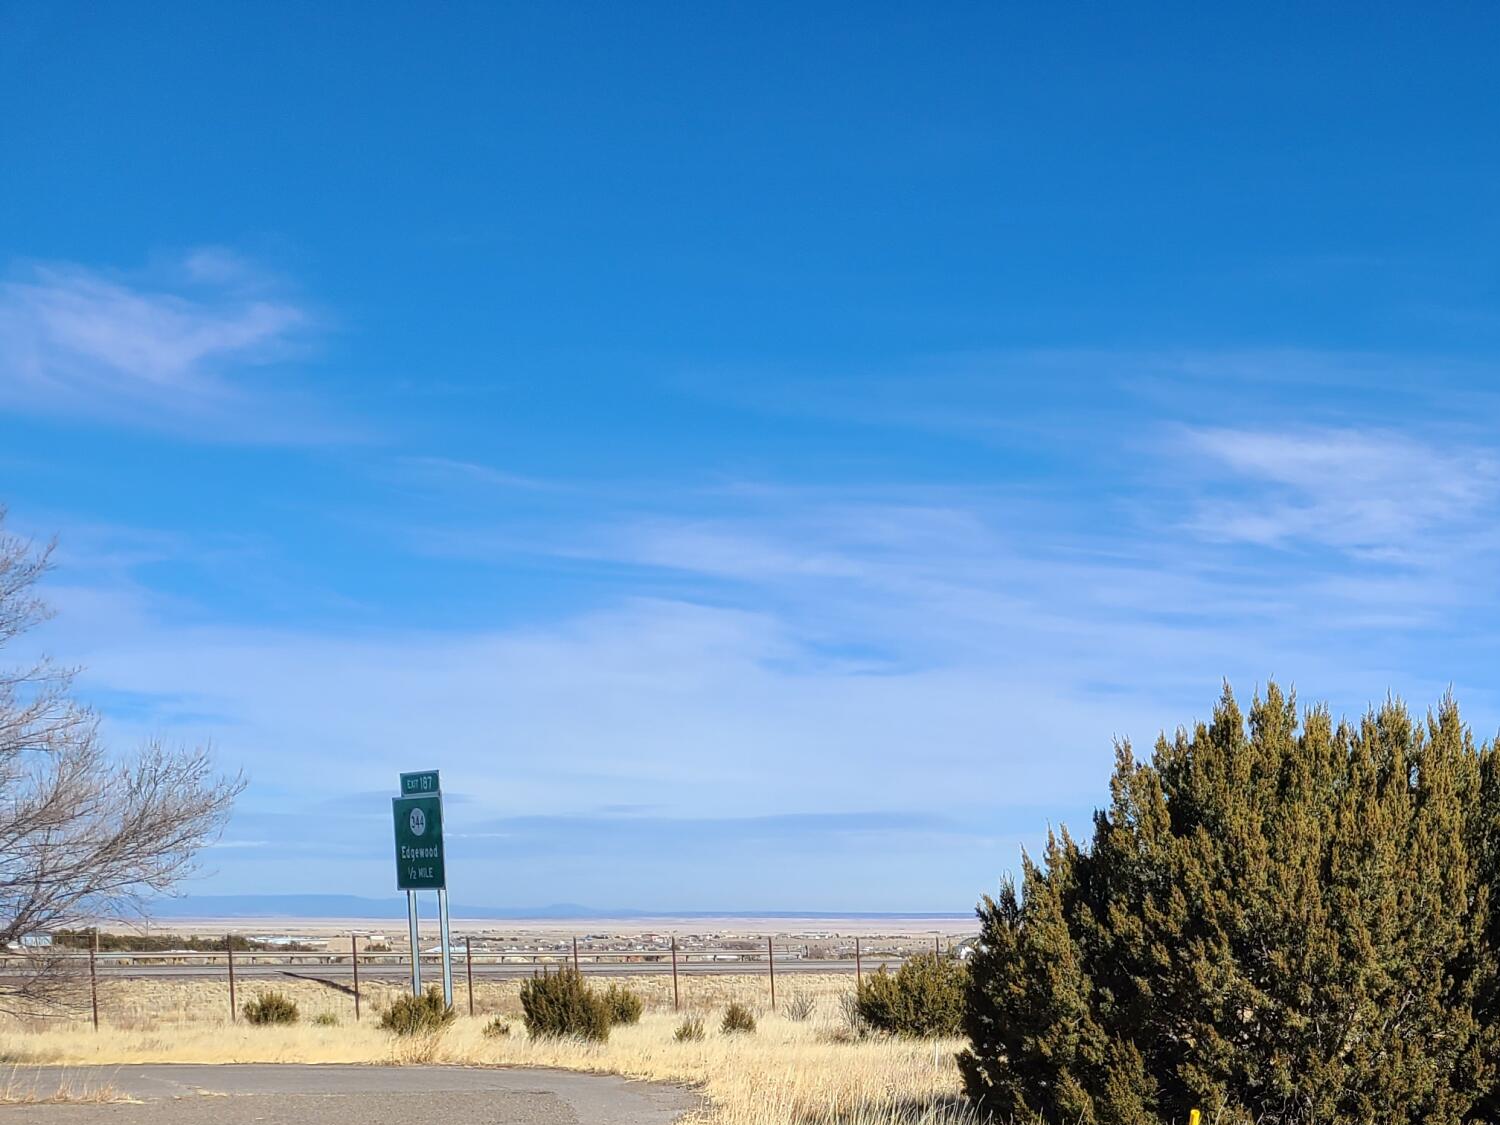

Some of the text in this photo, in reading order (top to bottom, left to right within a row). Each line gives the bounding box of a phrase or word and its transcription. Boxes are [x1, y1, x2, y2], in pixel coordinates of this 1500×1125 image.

[406, 776, 432, 790] EXIT 187
[401, 844, 438, 862] Edgewood
[418, 867, 434, 878] MILE
